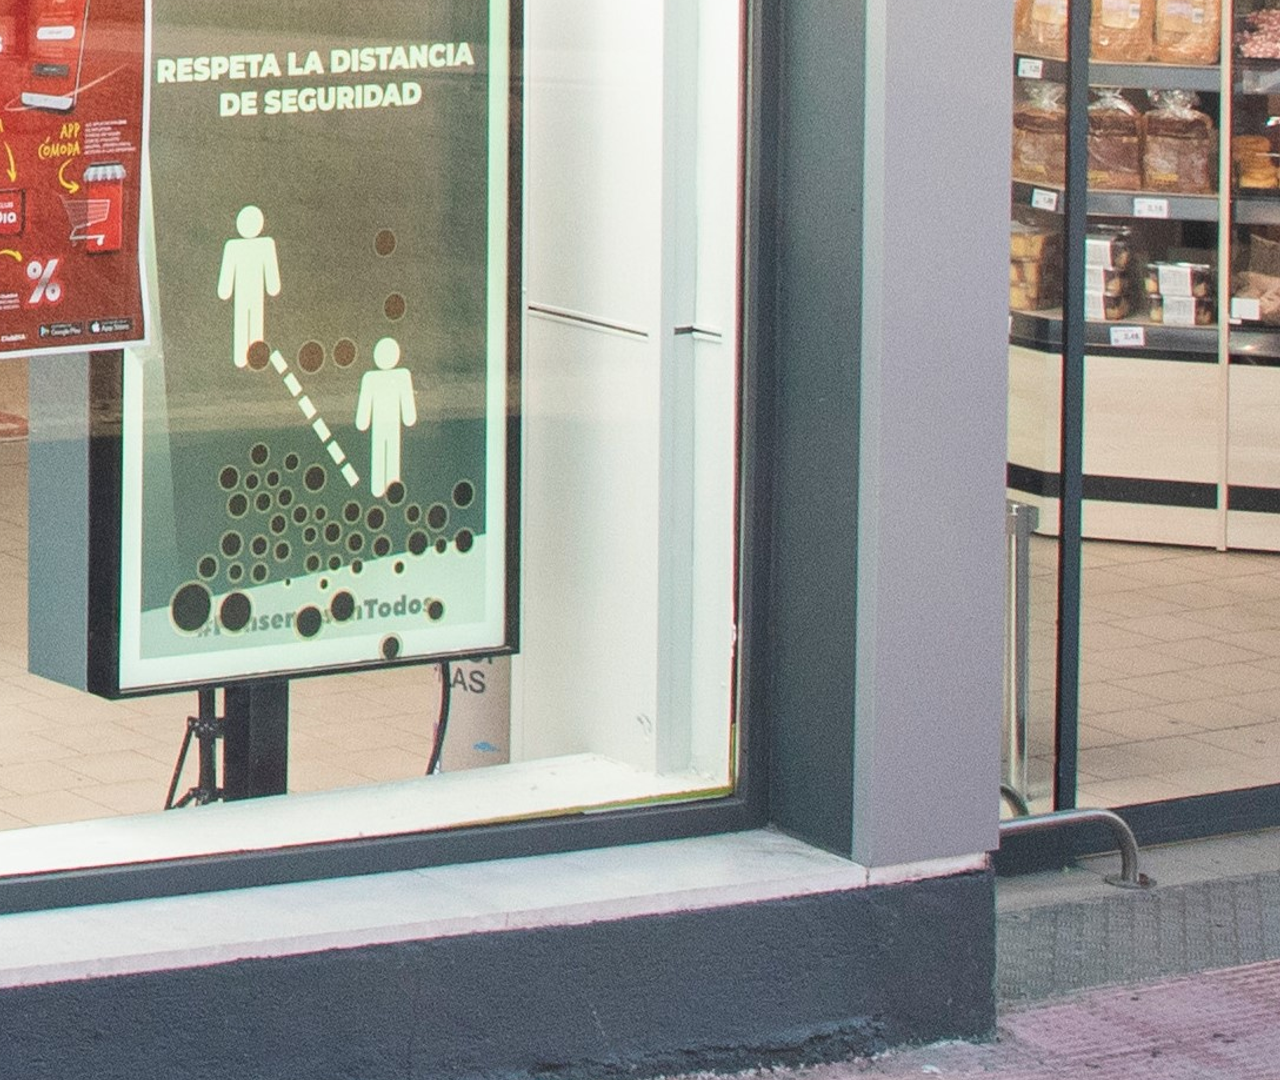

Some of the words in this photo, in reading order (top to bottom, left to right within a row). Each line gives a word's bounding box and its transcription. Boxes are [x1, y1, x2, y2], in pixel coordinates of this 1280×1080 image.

[157, 53, 281, 83] RESPETA
[287, 50, 324, 76] LA
[330, 42, 475, 73] DISTANCIA
[220, 92, 258, 117] DE
[264, 82, 422, 114] SEGURIDAD
[59, 122, 81, 139] APP
